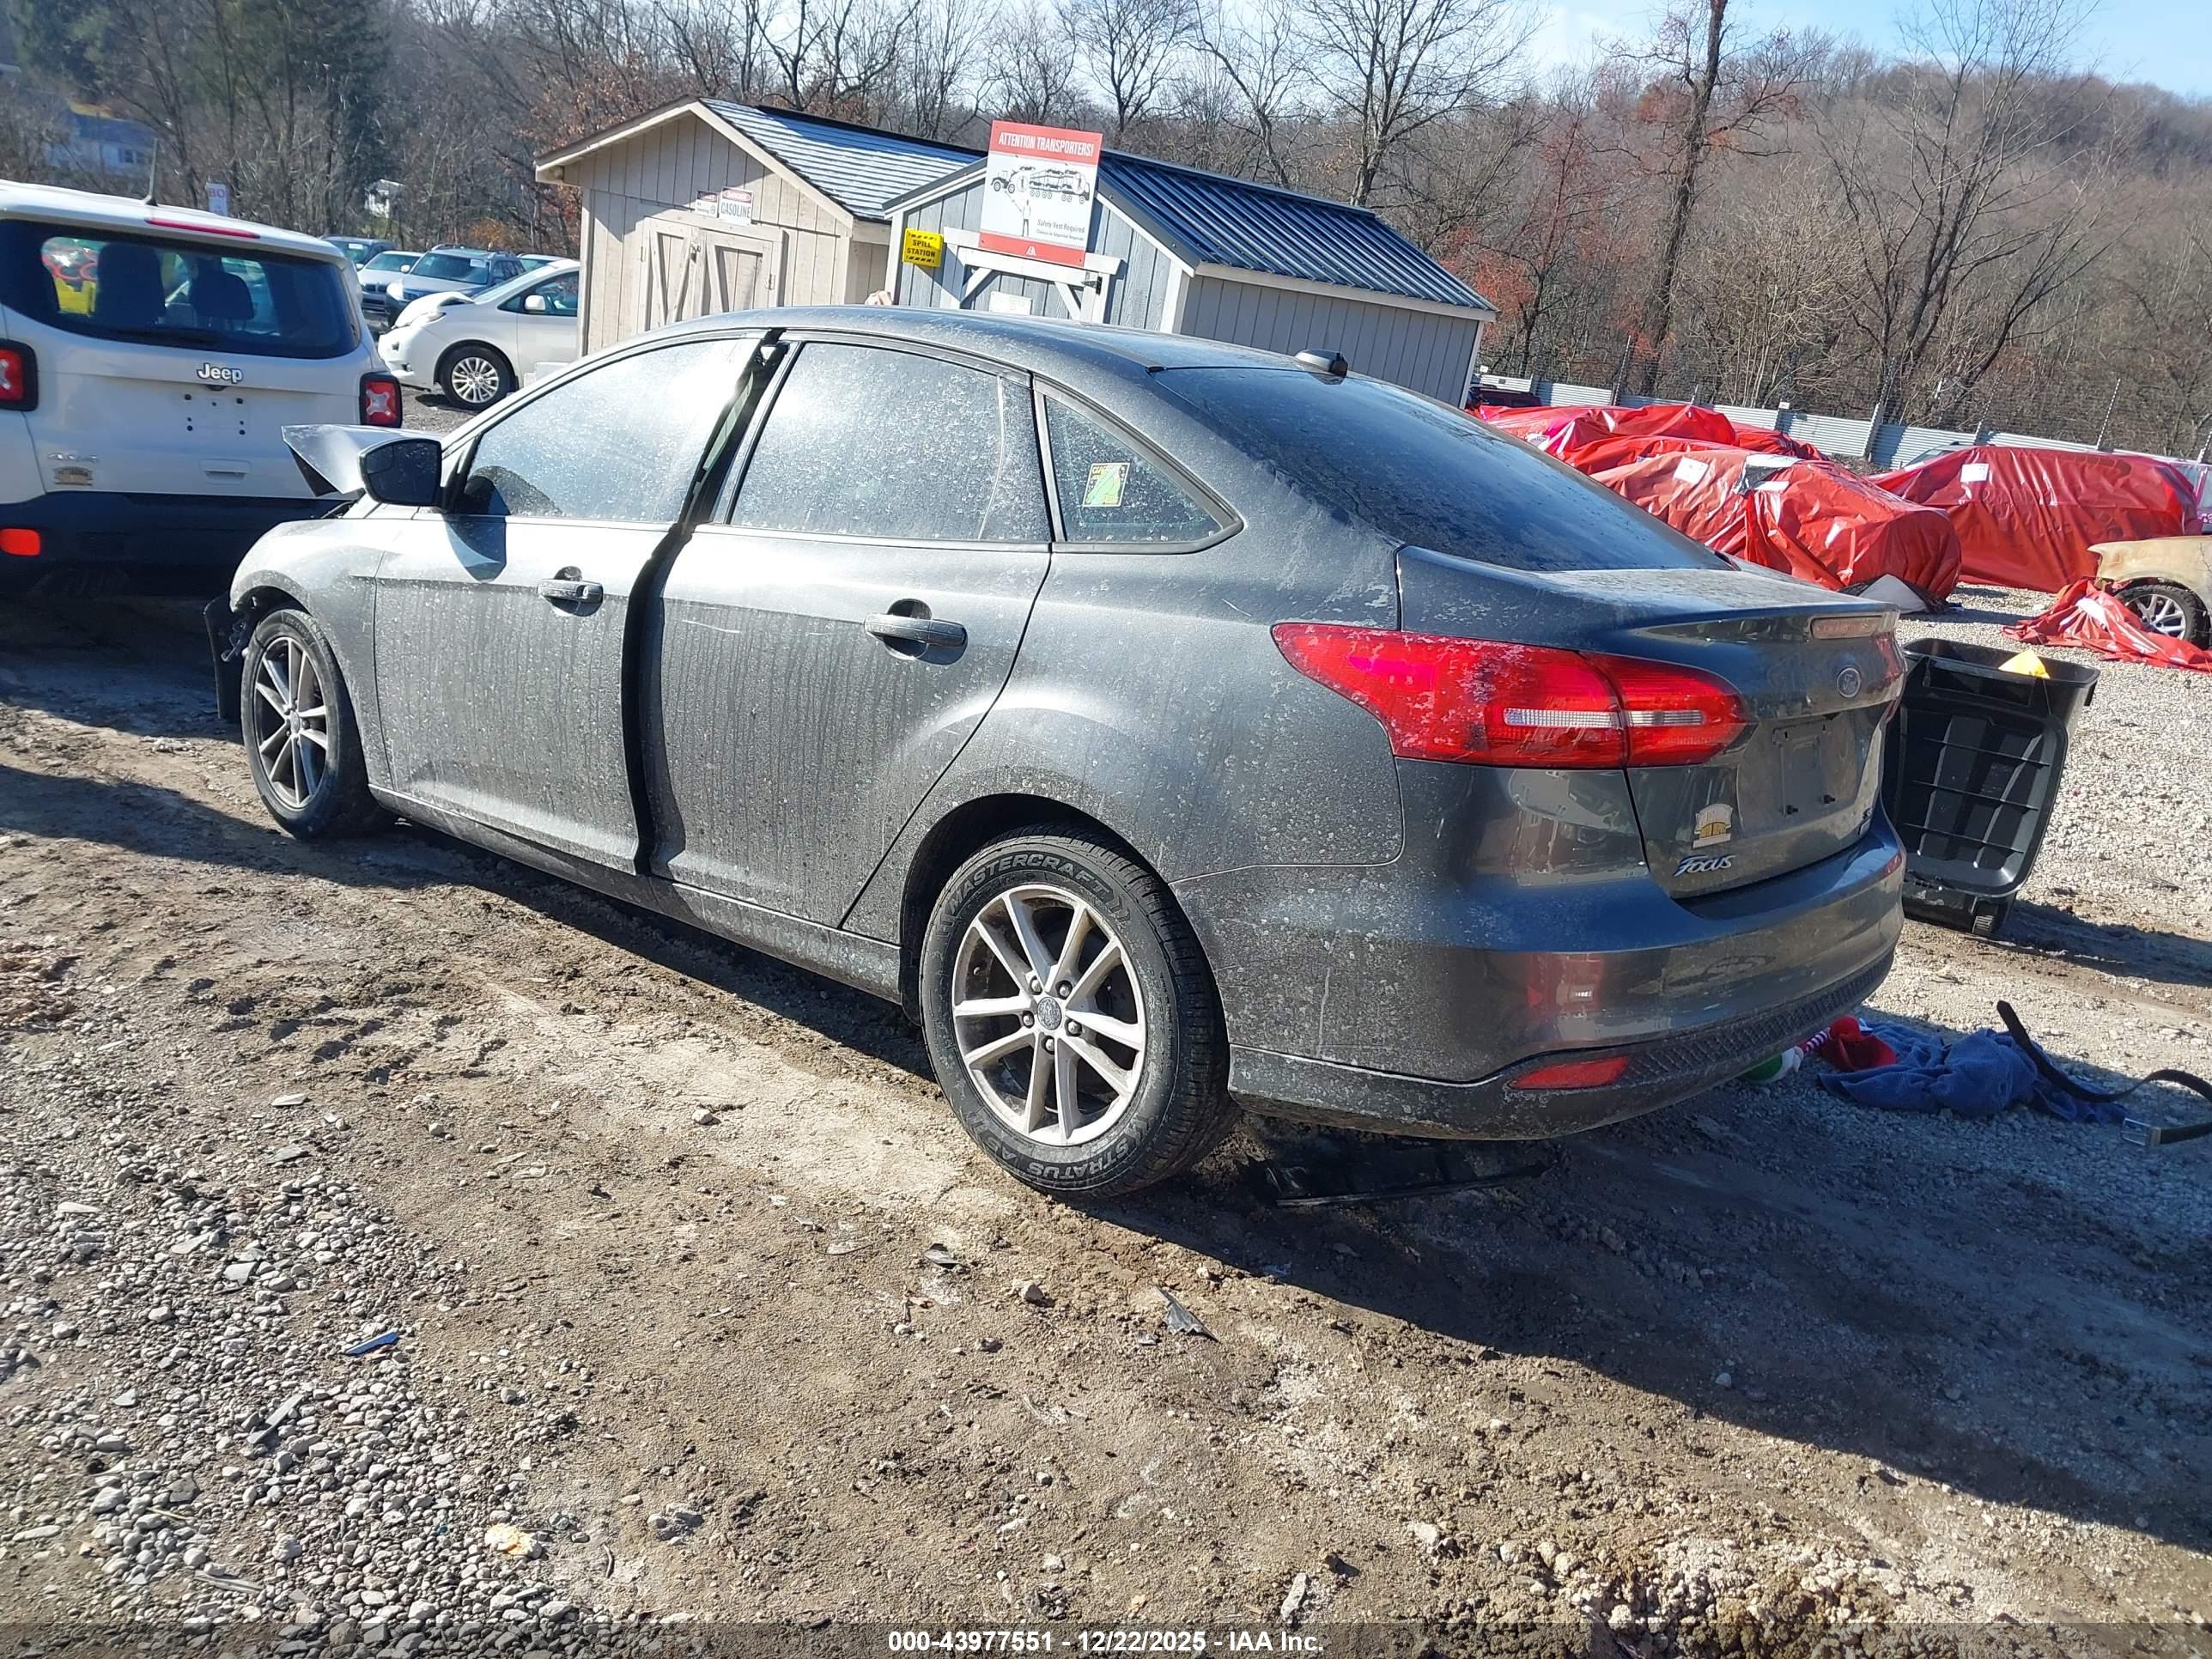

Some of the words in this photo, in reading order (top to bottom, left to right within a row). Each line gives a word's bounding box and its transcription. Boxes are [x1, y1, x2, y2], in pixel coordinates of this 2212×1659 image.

[998, 131, 1035, 149] ATTENTION
[1036, 137, 1095, 157] TRANSPORTERS!
[720, 202, 751, 219] GASOLINE
[1037, 219, 1052, 230] Safety
[906, 247, 936, 258] STATION
[912, 240, 932, 248] SPILL
[197, 362, 243, 384] Jeep
[1673, 854, 1736, 877] Focus
[951, 853, 1114, 913] MASTERCRAFT
[1027, 1137, 1129, 1180] STRATUS
